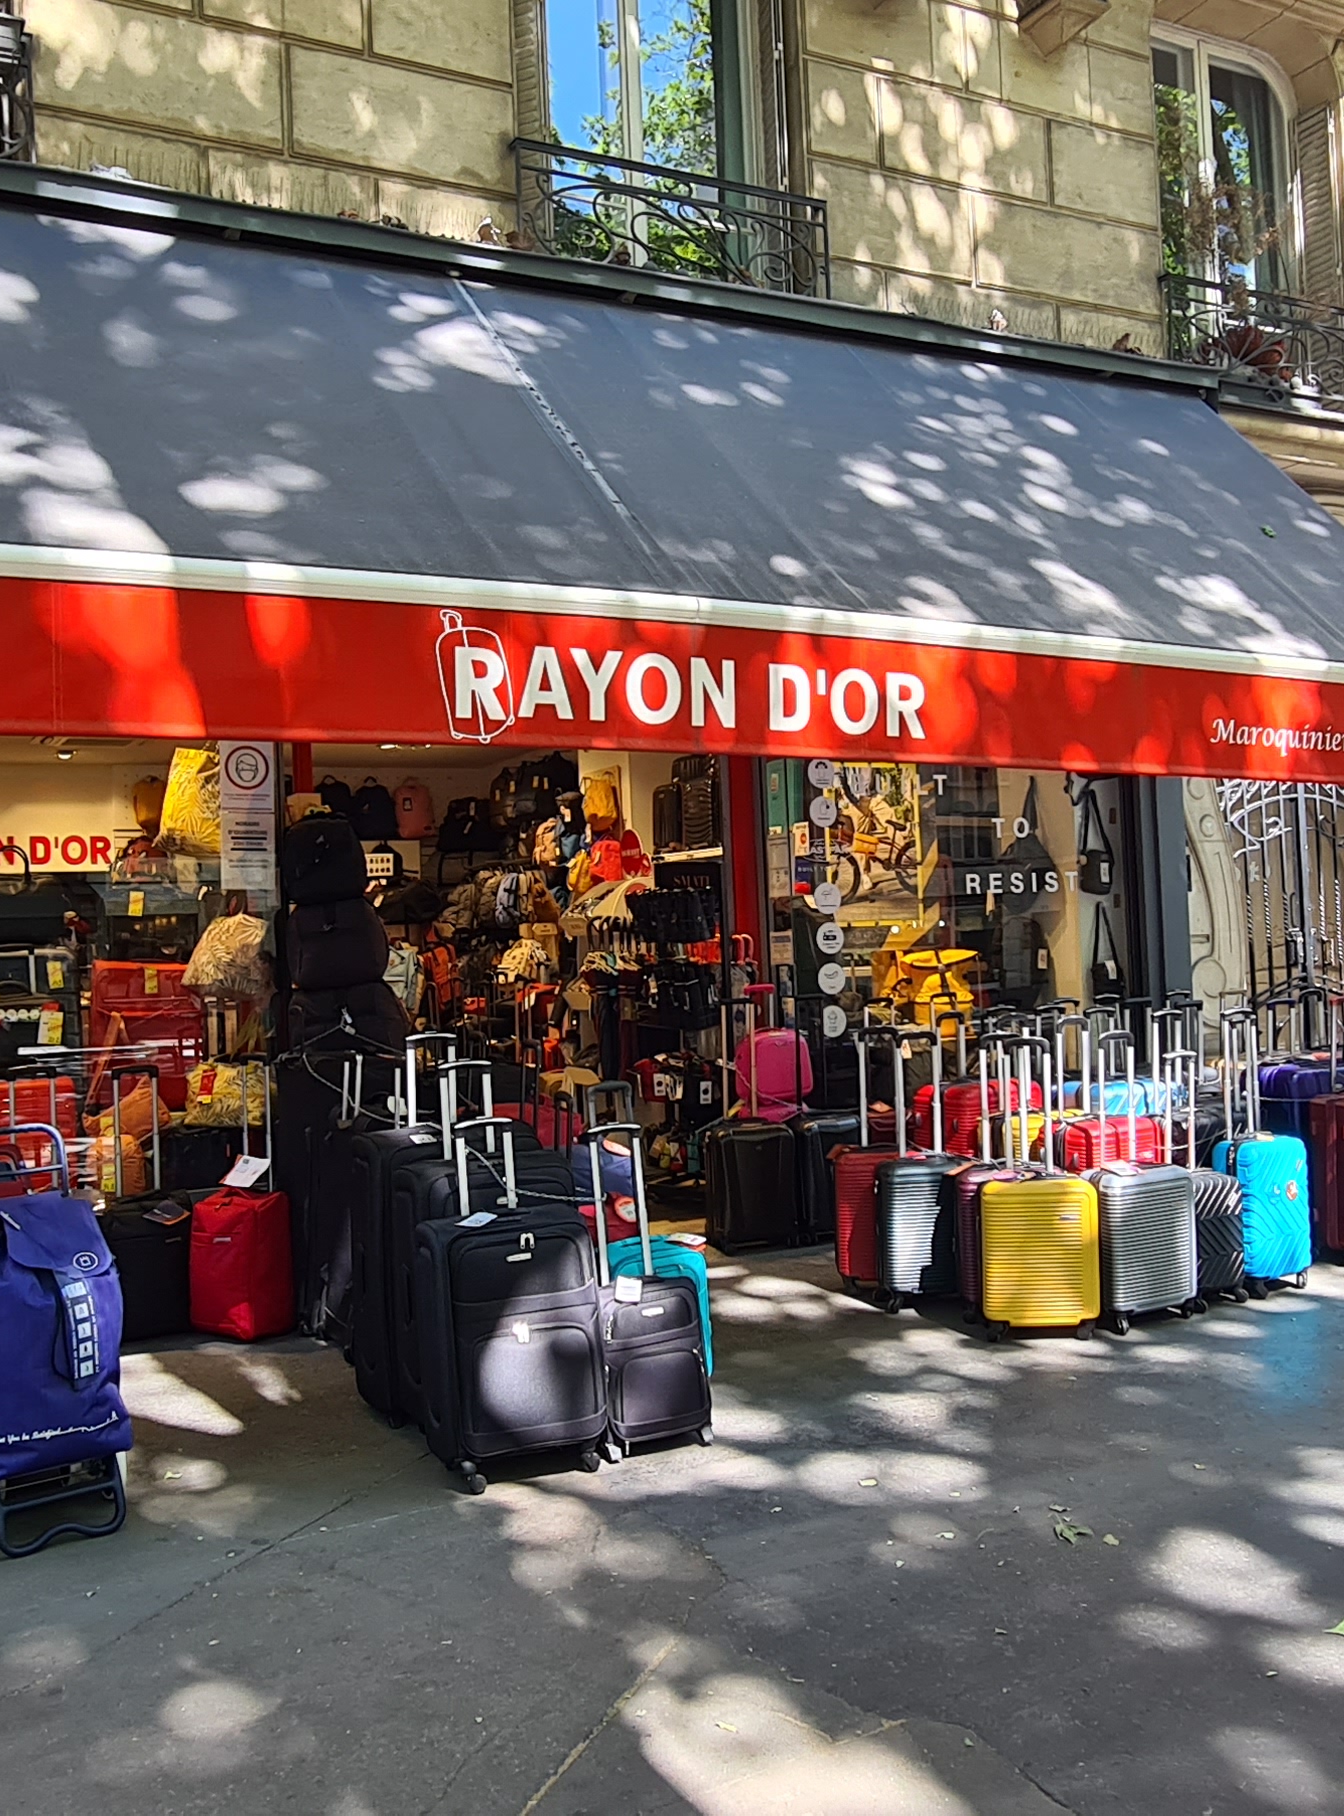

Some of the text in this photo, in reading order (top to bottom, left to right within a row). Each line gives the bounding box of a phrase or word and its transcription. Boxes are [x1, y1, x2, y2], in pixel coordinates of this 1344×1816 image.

[454, 645, 926, 740] RAYON D'OR
[991, 816, 1030, 839] TO
[29, 835, 111, 866] D'OR
[965, 870, 1079, 895] RESIST
